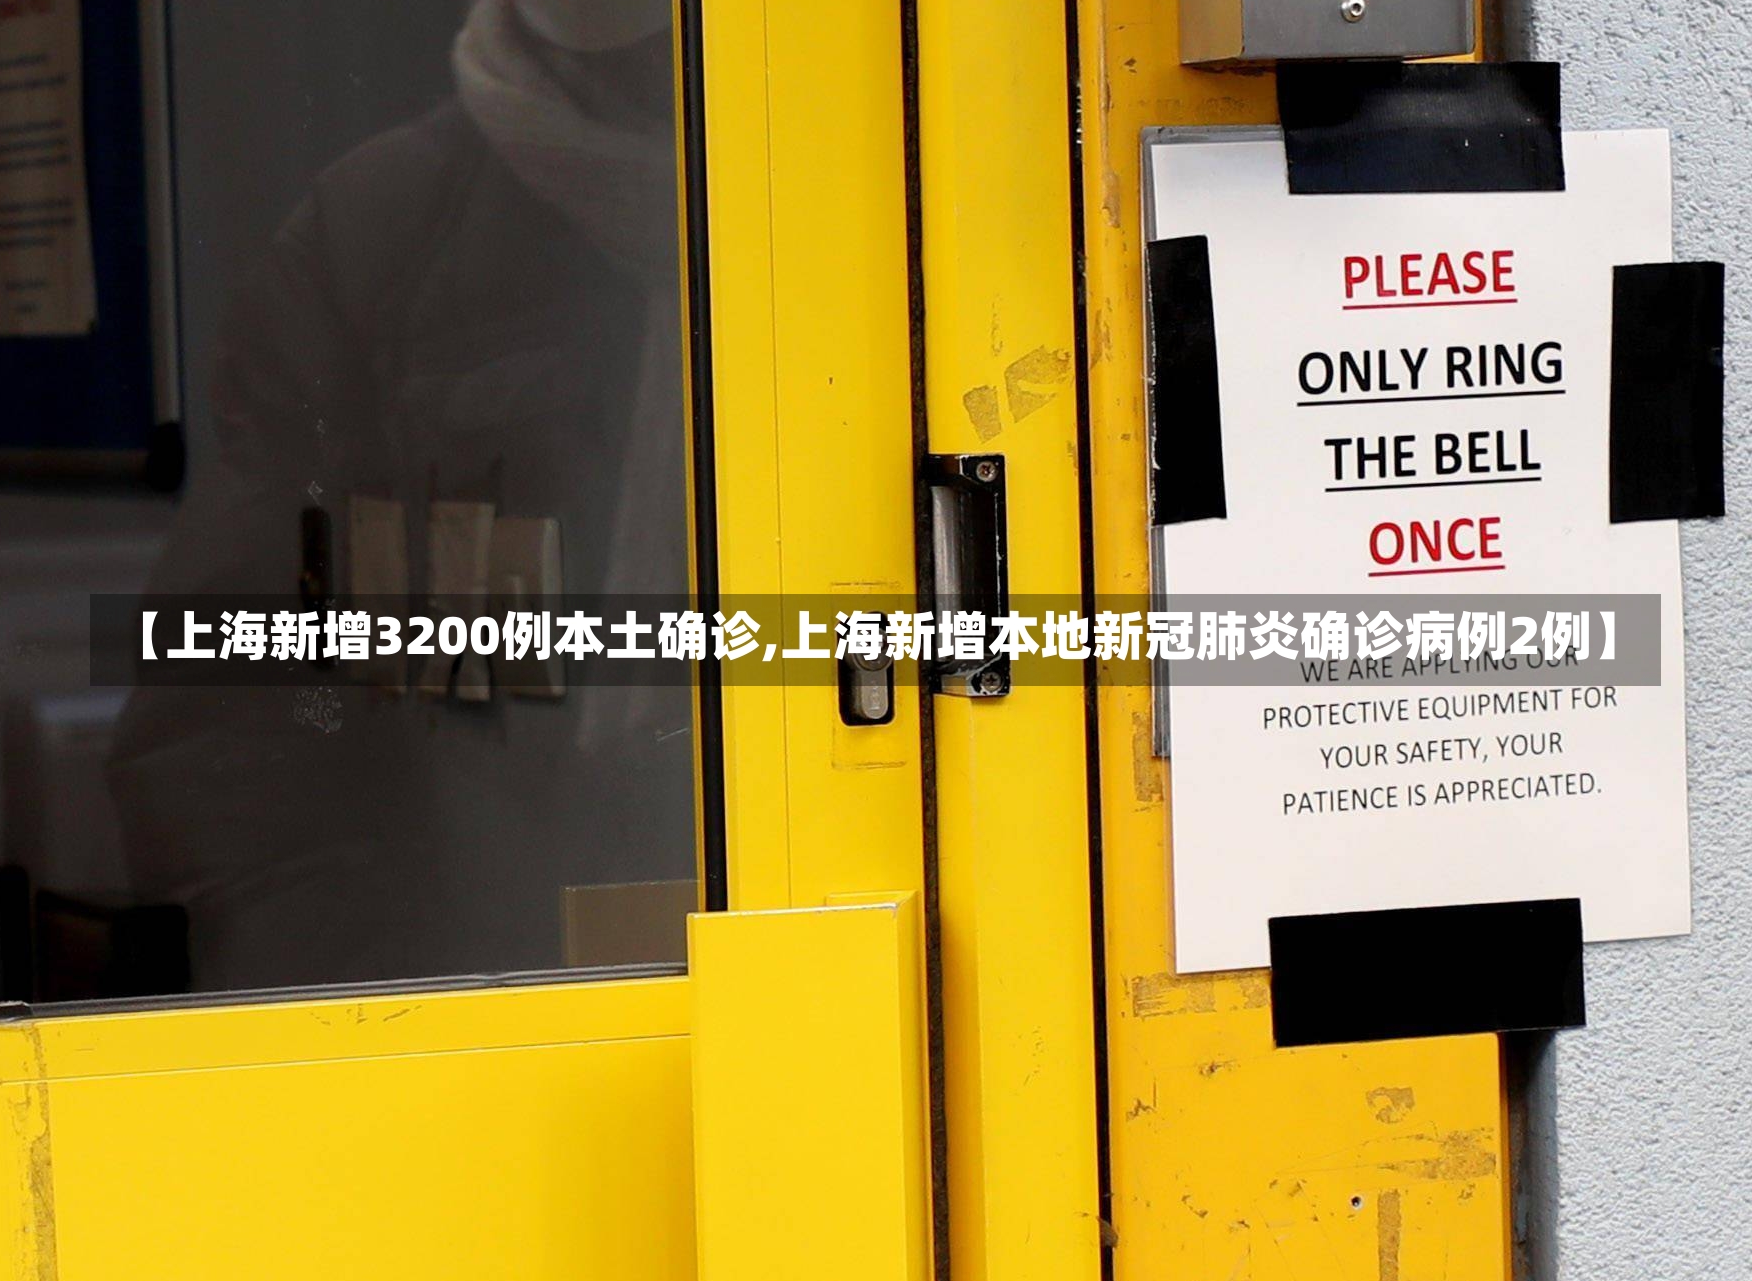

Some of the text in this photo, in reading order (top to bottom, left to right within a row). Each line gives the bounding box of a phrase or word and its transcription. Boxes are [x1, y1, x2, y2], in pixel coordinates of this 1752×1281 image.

[1343, 250, 1515, 297] PLEASE
[1297, 341, 1562, 394] ONLY RING
[1323, 429, 1541, 480] THE BELL
[1368, 516, 1502, 564] ONCE
[1300, 658, 1340, 683] WE
[1347, 655, 1393, 681] ARE
[1262, 684, 1618, 730] PROTECTIVE EQUIPMENT FOR
[1319, 731, 1563, 768] YOUR SAFETY, YOUR
[1283, 772, 1601, 814] PATIENCE IS APPRECIATED.
